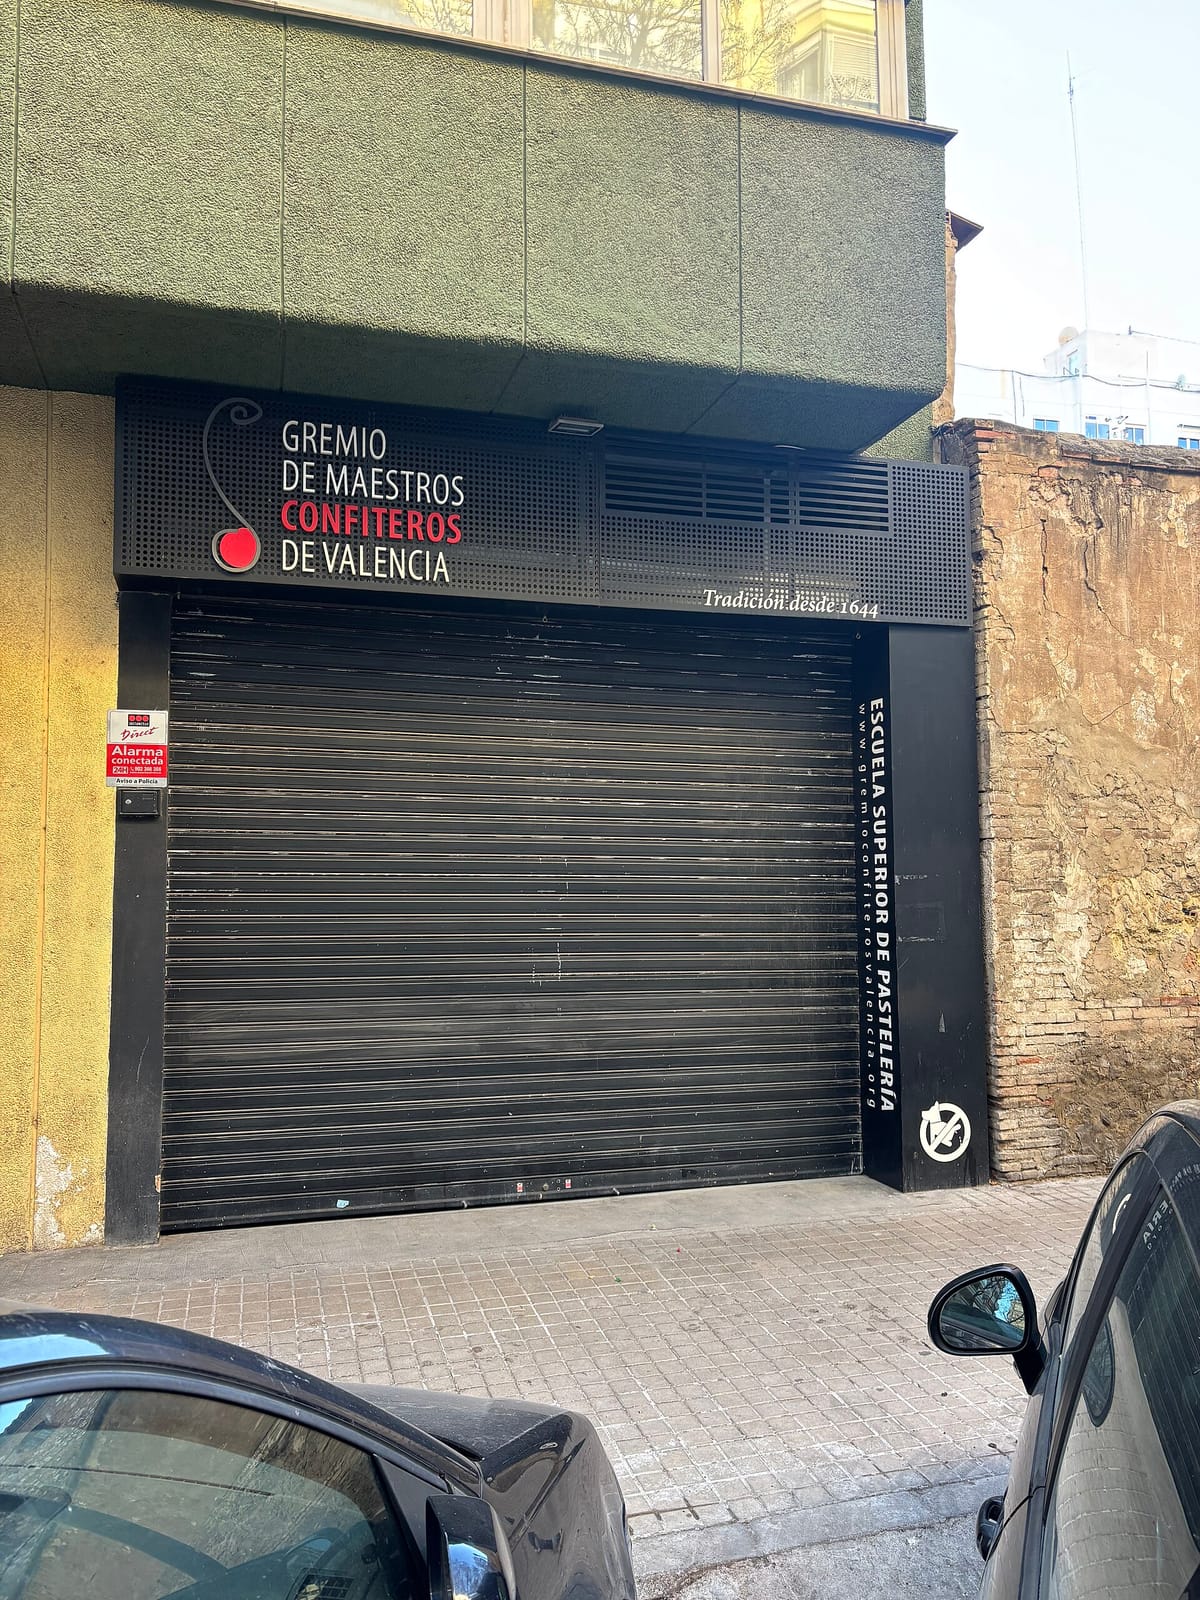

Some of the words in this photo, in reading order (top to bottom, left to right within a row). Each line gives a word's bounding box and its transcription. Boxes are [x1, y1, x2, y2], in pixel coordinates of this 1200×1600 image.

[282, 420, 387, 460] GREMIO
[282, 460, 315, 493] DE
[325, 463, 465, 507] MAESTROS
[281, 500, 462, 545] CONFITEROS
[282, 539, 315, 572] DE
[322, 542, 450, 583] VALENCIA
[703, 589, 785, 610] Tradición
[788, 595, 835, 613] desde
[840, 600, 879, 618] 1644
[111, 745, 163, 756] Alarma
[120, 726, 159, 741] Direct
[870, 697, 886, 799] ESCUELA
[111, 757, 163, 765] conectada
[873, 805, 889, 924] SUPERIOR
[876, 932, 890, 962] DE
[877, 969, 897, 1111] PASTELERÍA
